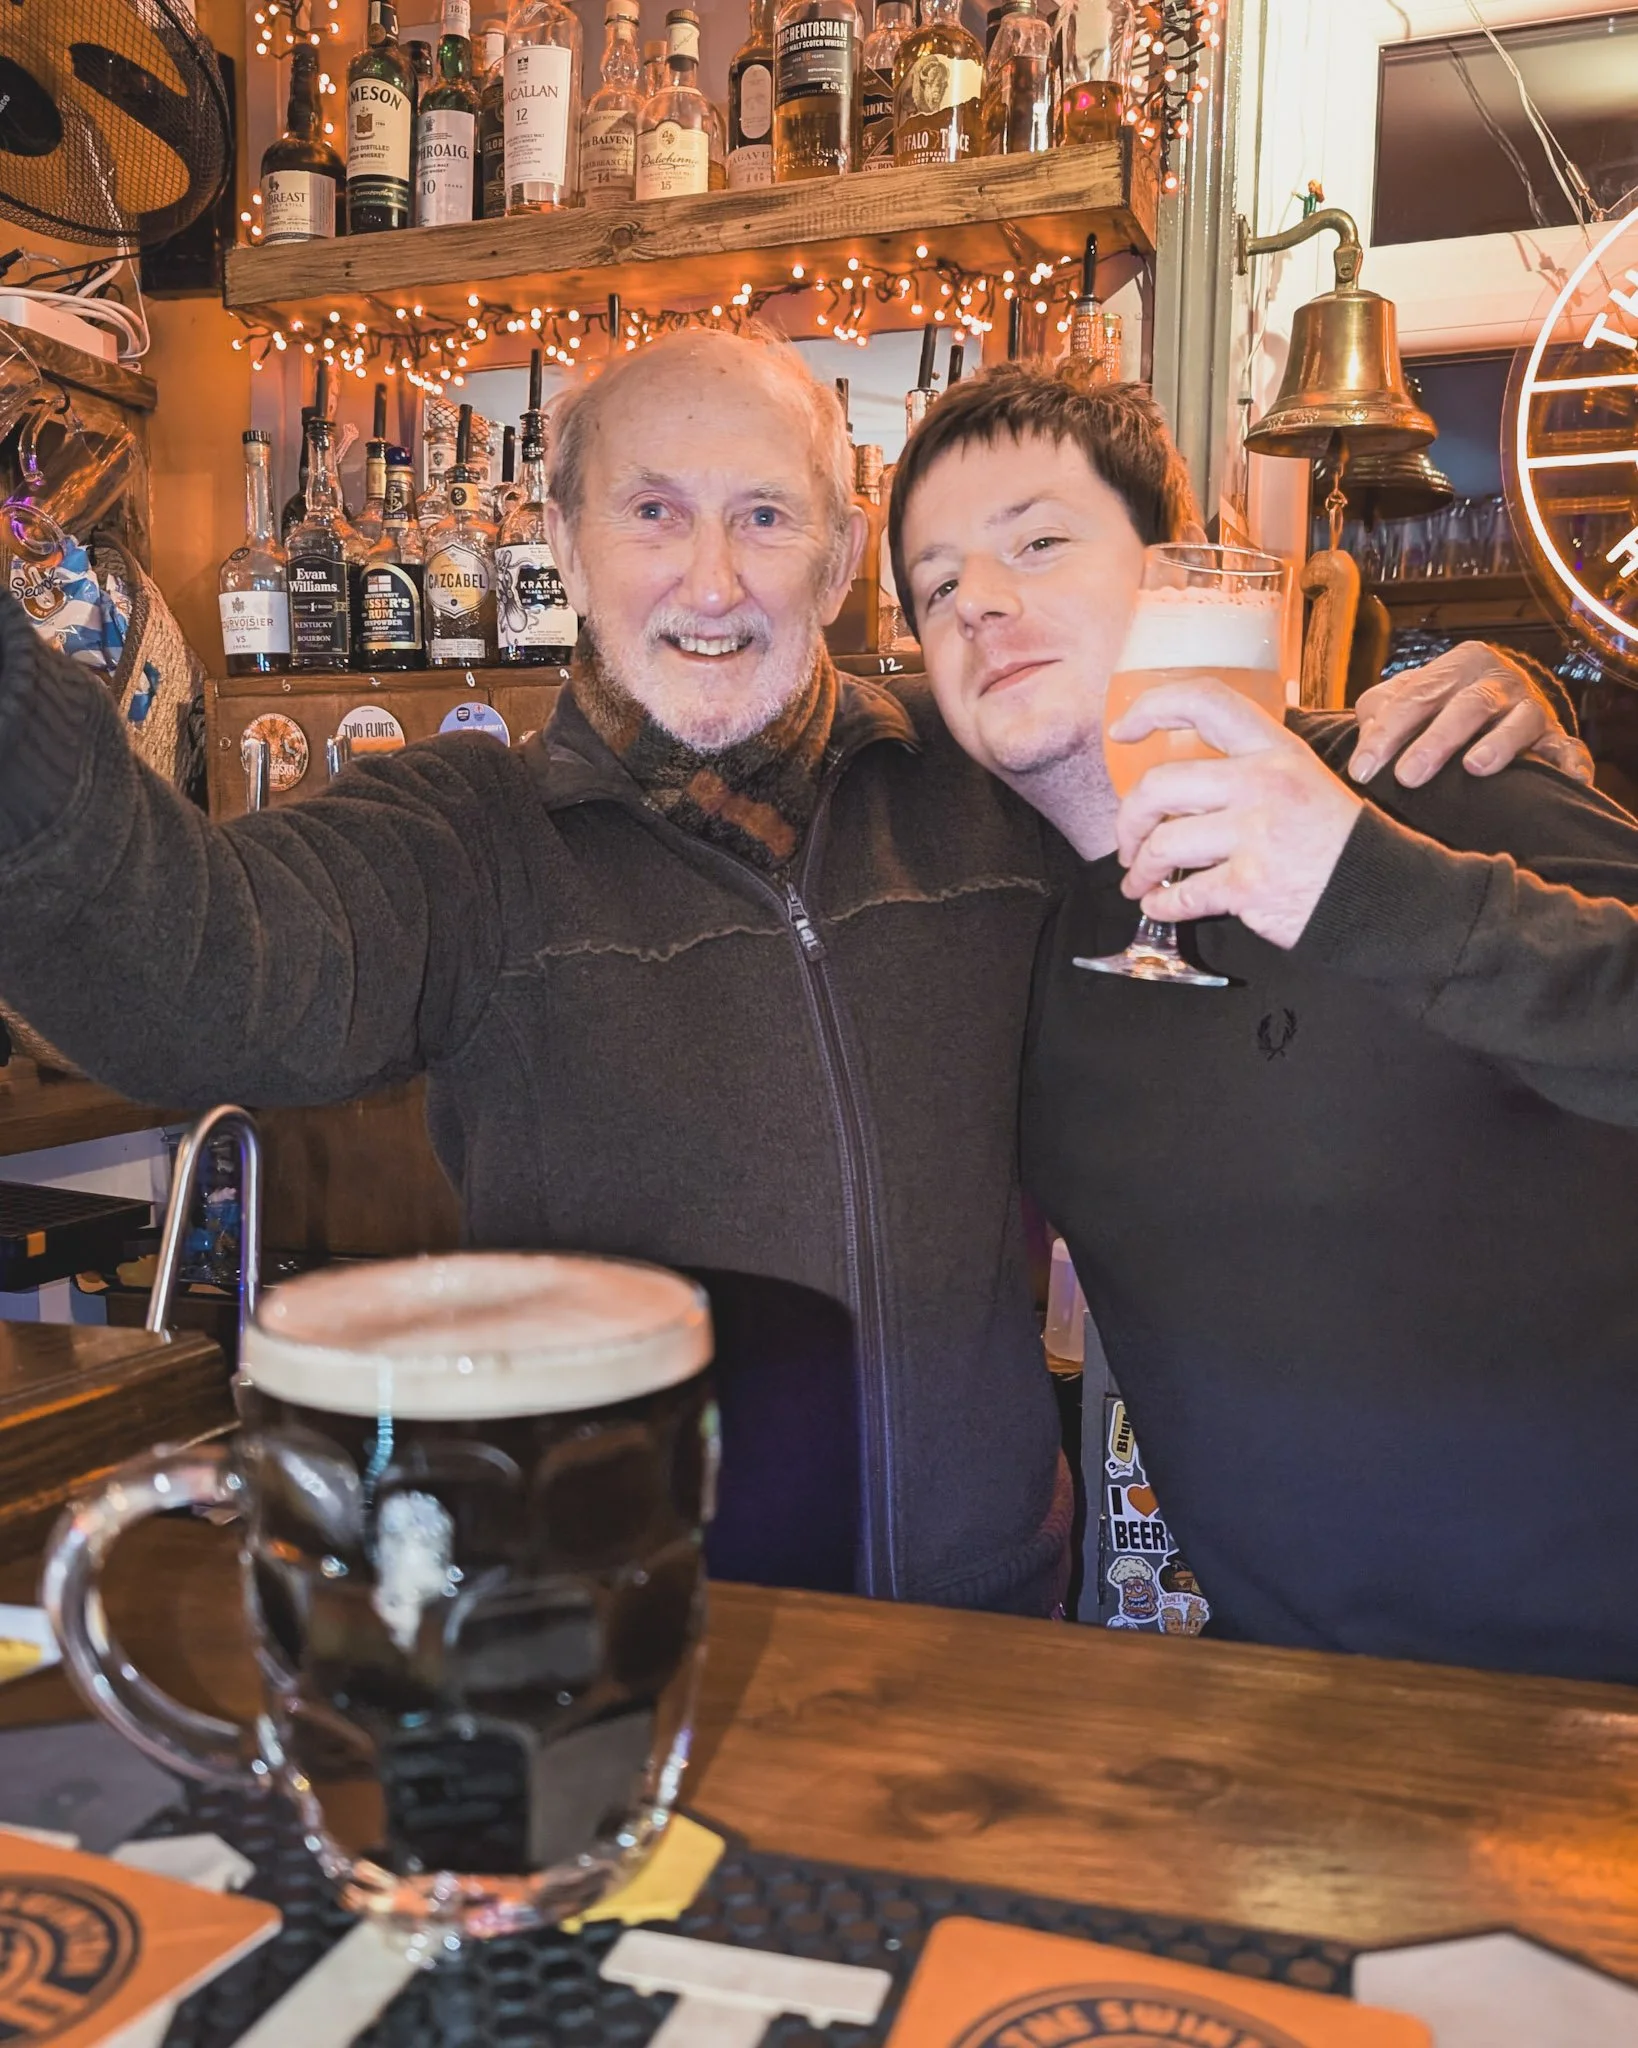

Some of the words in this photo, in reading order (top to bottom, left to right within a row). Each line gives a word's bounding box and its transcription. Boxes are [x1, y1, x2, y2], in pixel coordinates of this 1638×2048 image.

[802, 39, 824, 48] SCOTCH
[824, 38, 848, 48] WHISKY
[516, 107, 528, 121] 12
[592, 135, 633, 146] BALVENI
[423, 179, 436, 195] 10
[660, 181, 672, 190] 15
[296, 568, 327, 580] Evan
[428, 573, 486, 589] CAZCABEL
[235, 635, 247, 643] VS
[879, 657, 903, 674] 12
[282, 679, 291, 692] 6
[343, 723, 363, 739] TWO
[366, 722, 395, 738] FLINTS
[1111, 1487, 1124, 1516] I
[1114, 1521, 1167, 1550] BEER
